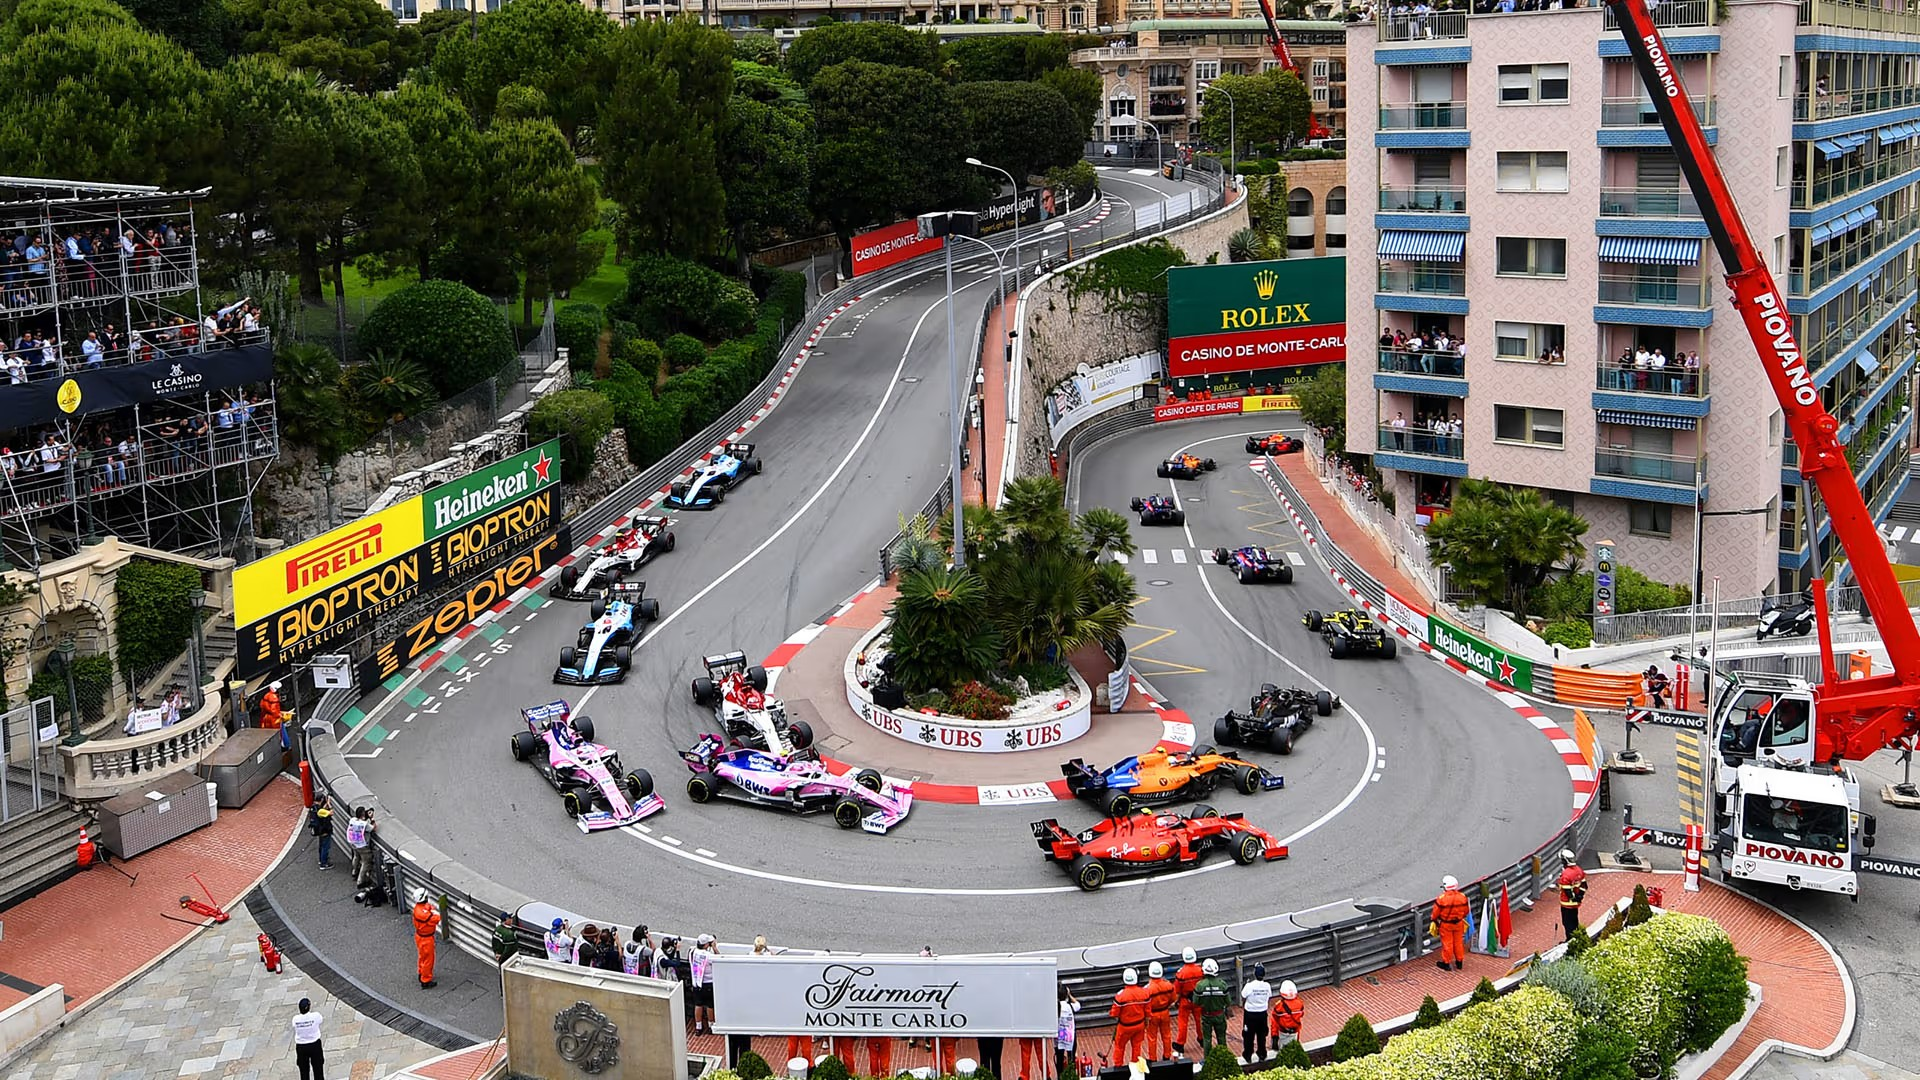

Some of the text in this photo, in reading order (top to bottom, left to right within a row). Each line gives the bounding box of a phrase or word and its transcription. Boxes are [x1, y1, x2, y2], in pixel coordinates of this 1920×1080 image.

[1643, 34, 1678, 97] PIOVANO
[989, 195, 1035, 220] Hyperight
[855, 232, 925, 262] CASINO DE MONTE-C
[1221, 303, 1311, 329] ROLEX
[1181, 346, 1233, 362] CASINO
[1236, 345, 1255, 357] DE
[1753, 291, 1817, 406] PIOVANO
[152, 373, 203, 390] LE CASINO
[1214, 382, 1239, 392] ROLEX
[1284, 375, 1313, 384] ROLEX
[1158, 401, 1239, 418] CASINO CAFE DE PARIS
[434, 470, 528, 530] Heineken
[447, 491, 550, 565] BIOPTRON
[285, 523, 382, 594] PIRELLI
[448, 521, 550, 577] HYPERLIGHT THERAPY
[277, 553, 419, 649] BIOPTRON
[279, 584, 419, 664] HYPERLIGHT THERAPY
[1434, 624, 1494, 674] Heineken
[873, 710, 902, 734] UBS
[1653, 712, 1704, 727] PIOVANO
[940, 728, 982, 747] UBS
[1027, 723, 1061, 747] UBS
[745, 779, 770, 796] BWT
[1007, 786, 1049, 799] UBS
[870, 821, 885, 830] BWT
[1082, 831, 1093, 841] 16
[1746, 843, 1844, 869] PIOVANO
[805, 964, 964, 1010] Fairmont
[805, 1012, 968, 1029] MONTE CARLO
